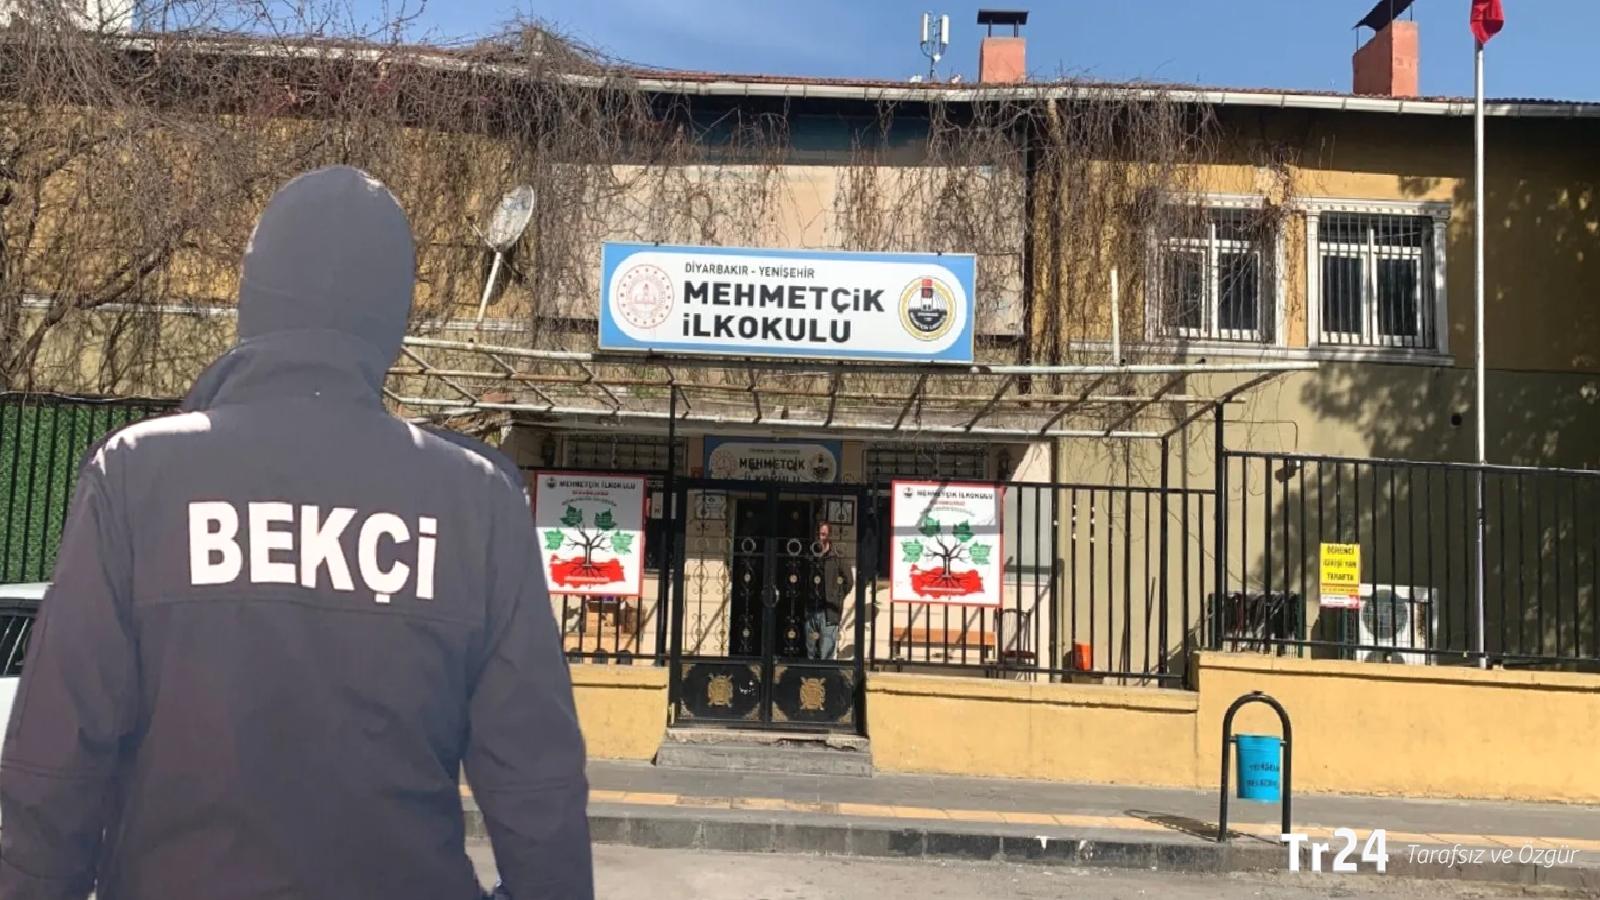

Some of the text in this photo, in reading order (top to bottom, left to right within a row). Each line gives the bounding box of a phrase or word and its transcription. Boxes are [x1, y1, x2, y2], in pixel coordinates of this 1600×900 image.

[685, 261, 748, 275] DİYARBAKIR
[759, 265, 815, 278] YENİŞEHİR
[684, 280, 885, 313] MEHMETÇİK
[683, 313, 852, 343] İLKOKULU
[188, 501, 437, 603] BEKÇİ
